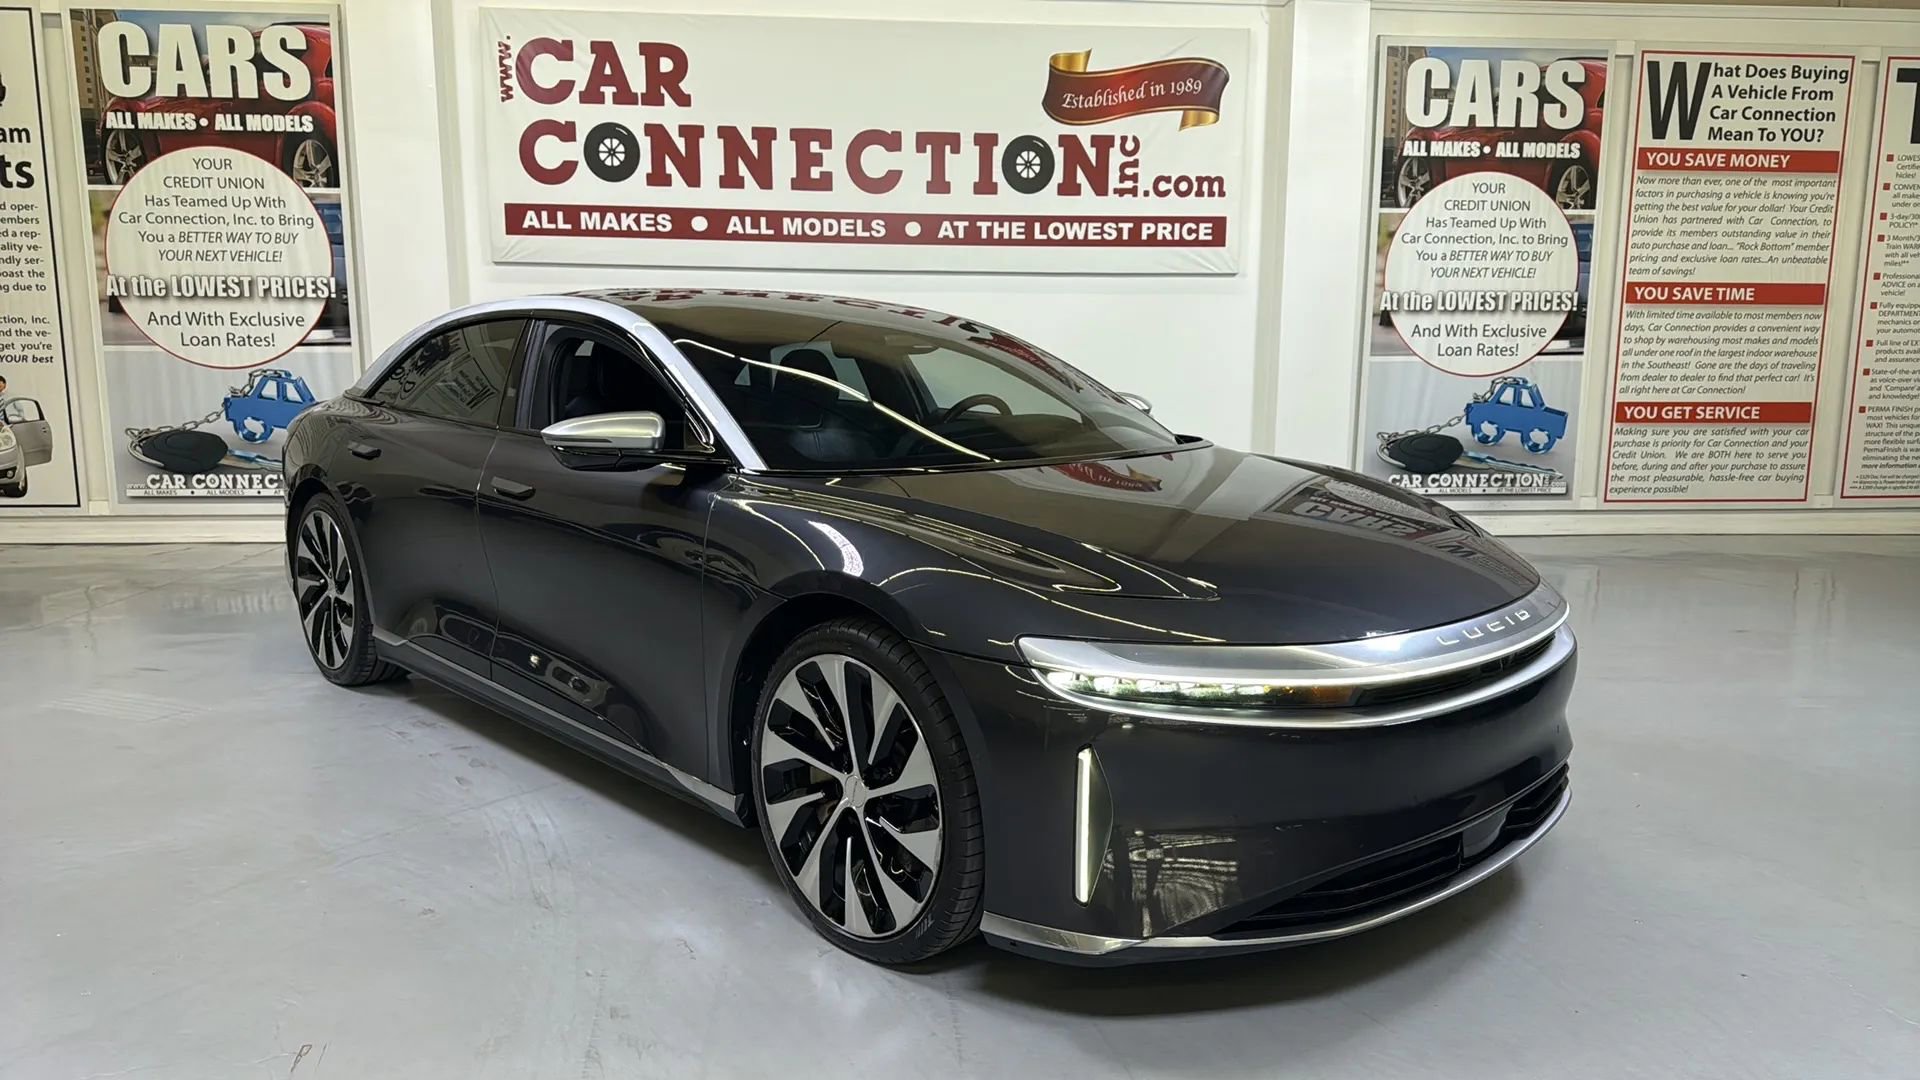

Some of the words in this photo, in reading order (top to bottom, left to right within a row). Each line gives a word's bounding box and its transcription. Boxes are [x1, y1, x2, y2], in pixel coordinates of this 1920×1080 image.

[98, 21, 311, 100] CARS
[516, 37, 691, 107] CAR
[1746, 64, 1787, 79] Does
[1791, 65, 1849, 83] Buying
[1062, 81, 1150, 109] Established
[1150, 83, 1166, 97] in
[1170, 78, 1202, 95] 1989
[1406, 57, 1585, 130] CARS
[1711, 85, 1723, 98] A
[1728, 85, 1787, 100] Vehicle
[1792, 87, 1833, 100] From
[1710, 106, 1737, 120] Car
[1742, 107, 1835, 122] Connection
[106, 112, 134, 129] ALL
[137, 112, 197, 130] MAKES
[214, 114, 243, 131] ALL
[247, 115, 313, 132] MODELS
[1708, 127, 1753, 141] Mean
[1758, 128, 1776, 142] To
[1781, 128, 1824, 142] YOU?
[1403, 141, 1427, 156] ALL
[1430, 141, 1480, 158] MAKES
[1495, 142, 1521, 158] ALL
[1525, 142, 1580, 159] MODELS
[193, 158, 232, 170] YOUR
[519, 119, 1114, 197] CONNECTION
[1647, 152, 1680, 166] YOU
[1685, 153, 1726, 167] SAVE
[1730, 154, 1790, 168] MONEY
[164, 177, 214, 188] CREDIT
[217, 178, 264, 189] UNION
[1144, 175, 1226, 197] .com
[1473, 183, 1505, 193] YOUR
[1636, 176, 1656, 185] Now
[1682, 177, 1701, 185] than
[1743, 178, 1753, 187] of
[1754, 178, 1767, 186] the
[1772, 179, 1792, 187] most
[1795, 179, 1836, 188] important
[145, 195, 170, 206] Has
[173, 195, 227, 208] Teamed
[232, 197, 251, 210] Up
[254, 197, 286, 208] With
[1444, 200, 1487, 211] CREDIT
[1490, 201, 1531, 211] UNION
[119, 212, 141, 224] Car
[146, 212, 229, 226] Connection,
[233, 214, 257, 225] Inc.
[262, 216, 274, 225] to
[279, 215, 314, 228] Bring
[523, 211, 572, 229] ALL
[580, 212, 672, 232] MAKES
[726, 216, 774, 234] ALL
[783, 218, 886, 237] MODELS
[938, 221, 968, 239] AT
[976, 221, 1026, 240] THE
[1034, 222, 1133, 240] LOWEST
[1141, 222, 1212, 240] PRICE
[1426, 217, 1447, 227] Has
[1451, 218, 1496, 228] Teamed
[1500, 218, 1518, 230] Up
[1520, 218, 1546, 228] With
[21, 230, 40, 239] rep-
[138, 231, 164, 242] You
[168, 234, 175, 242] a
[179, 232, 222, 243] BETTER
[226, 232, 252, 243] WAY
[256, 232, 272, 243] TO
[274, 233, 299, 244] BUY
[1402, 233, 1421, 243] Car
[1424, 234, 1496, 245] Connection,
[1499, 234, 1518, 244] Inc.
[1523, 235, 1534, 244] to
[1538, 234, 1568, 247] Bring
[159, 250, 192, 261] YOUR
[195, 250, 227, 261] NEXT
[230, 250, 283, 262] VEHICLE!
[1416, 250, 1437, 261] You
[1450, 251, 1487, 261] BETTER
[1490, 251, 1513, 261] WAY
[1516, 251, 1529, 261] TO
[1532, 251, 1553, 261] BUY
[28, 269, 45, 278] the
[1430, 268, 1459, 277] YOUR
[1462, 268, 1490, 278] NEXT
[1492, 268, 1536, 278] VEHICLE!
[13, 282, 32, 291] due
[107, 275, 127, 296] At
[132, 276, 166, 296] the
[171, 276, 252, 297] LOWEST
[257, 277, 336, 298] PRICES!
[1635, 287, 1668, 300] YOU
[1672, 288, 1712, 300] SAVE
[1716, 288, 1755, 300] TIME
[1380, 291, 1398, 311] At
[1403, 291, 1432, 311] the
[1437, 292, 1507, 311] LOWEST
[1511, 292, 1579, 311] PRICES!
[32, 316, 50, 324] Inc.
[148, 312, 181, 325] And
[185, 312, 224, 326] With
[230, 312, 304, 326] Exclusive
[15, 329, 32, 337] the
[1411, 324, 1441, 337] And
[1445, 324, 1478, 337] With
[1483, 325, 1546, 337] Exclusive
[21, 342, 52, 352] you're
[181, 333, 220, 346] Loan
[227, 333, 275, 347] Rates!
[1438, 343, 1471, 356] Loan
[1477, 343, 1518, 356] Rates!
[32, 355, 53, 363] best
[1625, 407, 1657, 419] YOU
[1662, 407, 1692, 419] GET
[1696, 407, 1760, 419] SERVICE
[1615, 428, 1647, 437] Making
[1673, 429, 1689, 438] you
[1711, 427, 1746, 436] satisfied
[1750, 428, 1769, 436] with
[1772, 429, 1791, 438] your
[147, 474, 186, 488] CAR
[1388, 474, 1422, 488] CAR
[1428, 473, 1544, 488] CONNECTION
[1437, 609, 1530, 645] LUCID
